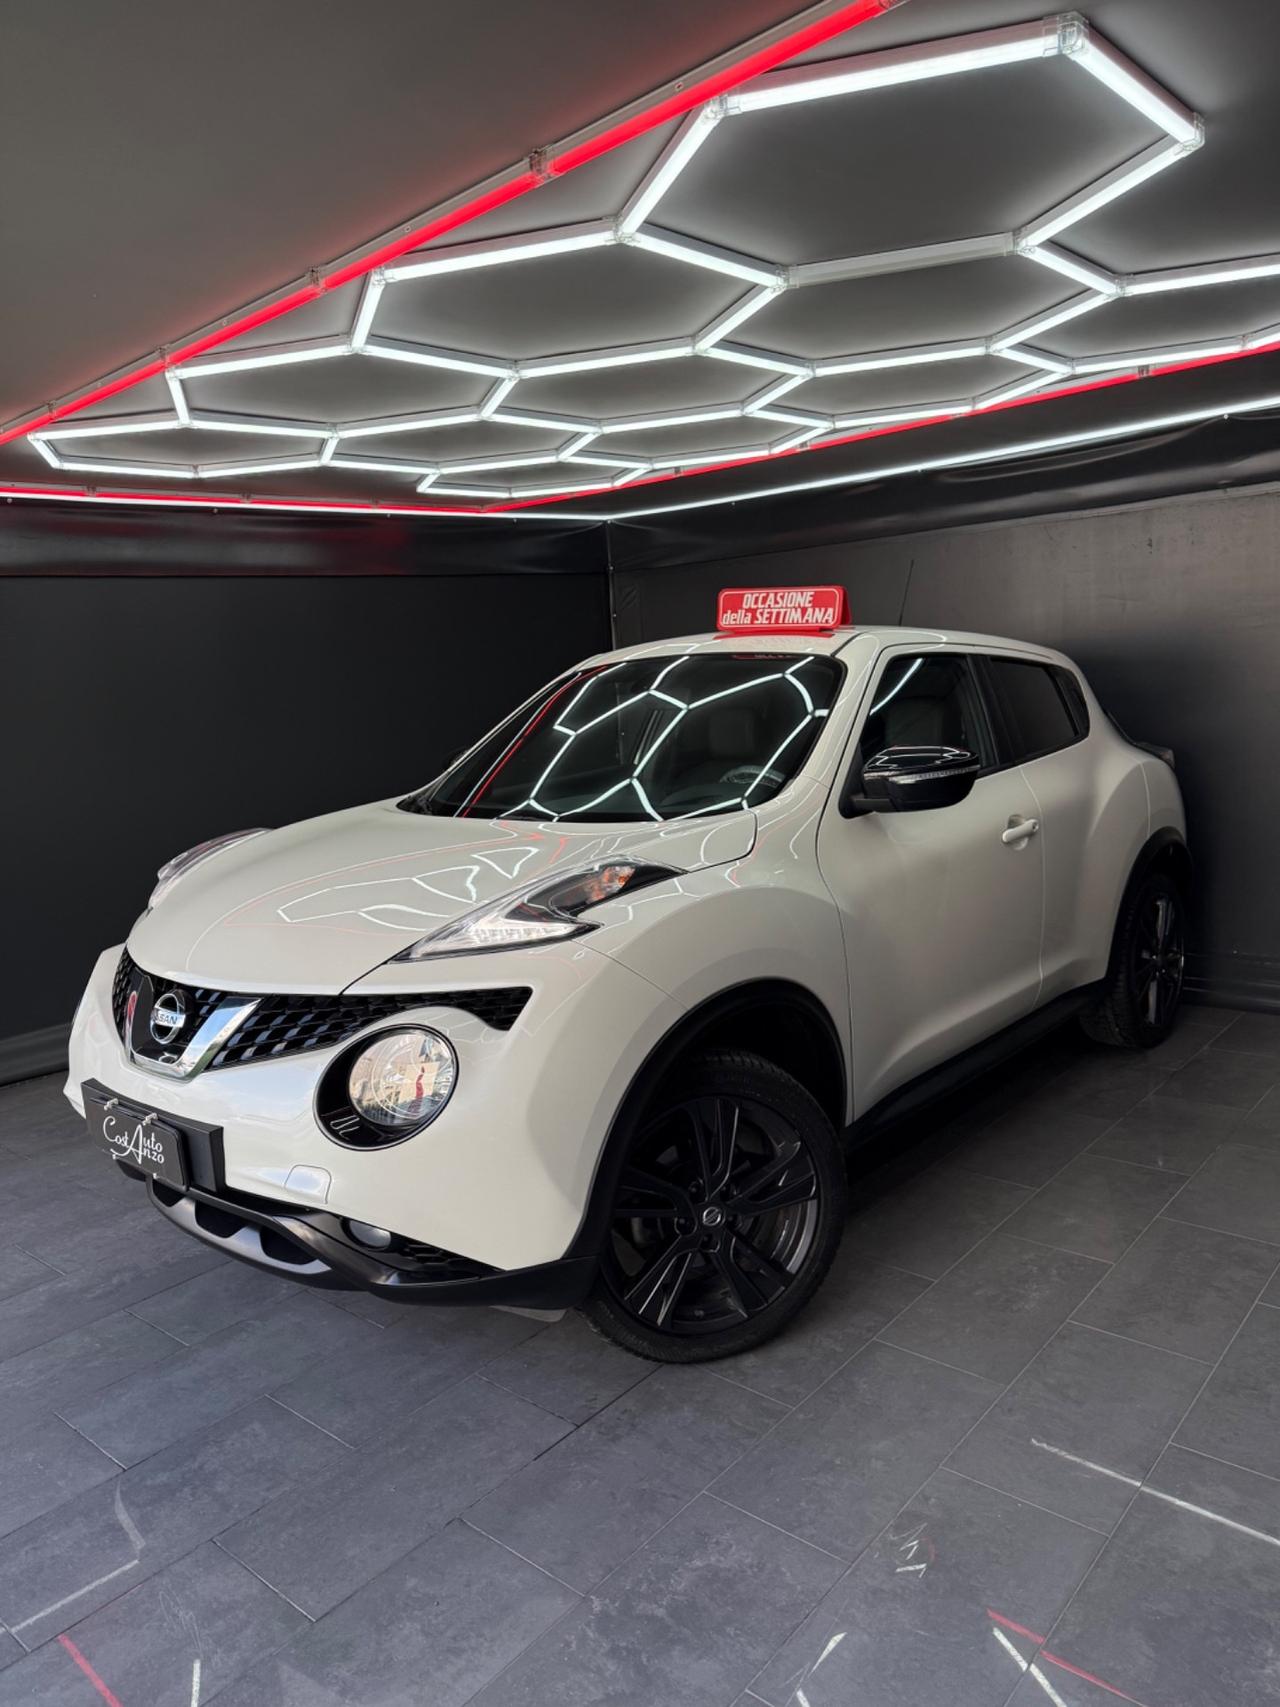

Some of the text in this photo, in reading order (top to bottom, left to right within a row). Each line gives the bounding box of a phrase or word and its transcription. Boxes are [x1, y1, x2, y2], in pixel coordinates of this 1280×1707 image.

[743, 591, 815, 609] OCCASIONE
[722, 607, 834, 625] della SETTIMANA
